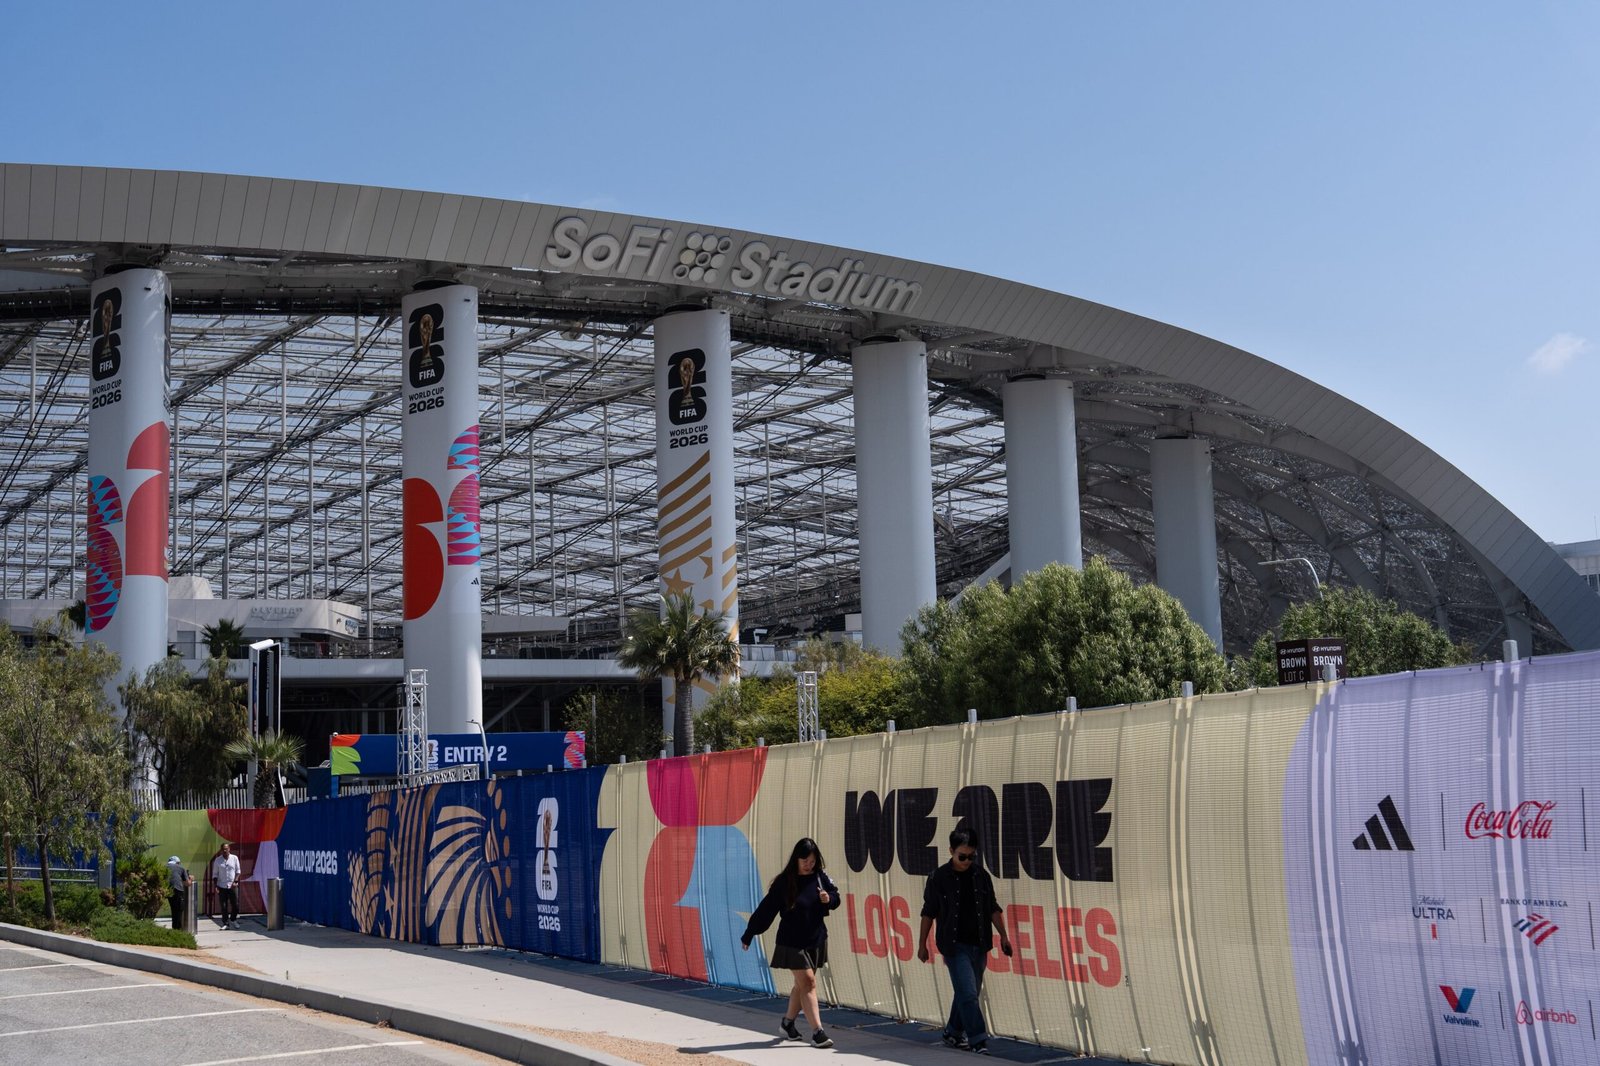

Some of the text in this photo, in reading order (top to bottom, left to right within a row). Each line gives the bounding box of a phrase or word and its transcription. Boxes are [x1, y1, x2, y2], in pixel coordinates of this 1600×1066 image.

[545, 216, 923, 313] SoFi Stadium
[99, 360, 114, 373] FIFA
[418, 368, 436, 380] FIFA
[92, 379, 122, 395] WORLD CUP
[408, 386, 445, 402] WORLD CUP
[91, 389, 122, 410] 2026
[408, 396, 445, 415] 2026
[679, 408, 697, 418] FIFA
[669, 424, 709, 437] WORLD CUP
[669, 433, 709, 449] 2026
[1281, 656, 1307, 669] BROWN
[1313, 655, 1343, 666] BROWN
[1284, 670, 1305, 682] LOT C
[444, 745, 507, 763] ENTRY 2
[1464, 800, 1558, 840] Coca-Cola
[844, 777, 1114, 883] WE ARE
[291, 849, 304, 872] WORLD
[304, 850, 316, 873] CUP
[315, 850, 338, 875] 2026
[541, 880, 552, 891] FIFA
[537, 903, 560, 915] WORLD CUP
[1522, 898, 1531, 906] OF
[1533, 899, 1569, 908] AMERICA
[1411, 906, 1456, 920] ULTRA
[538, 915, 561, 932] 2026
[845, 893, 1122, 989] LOS ELES
[1534, 1008, 1577, 1025] airbnb
